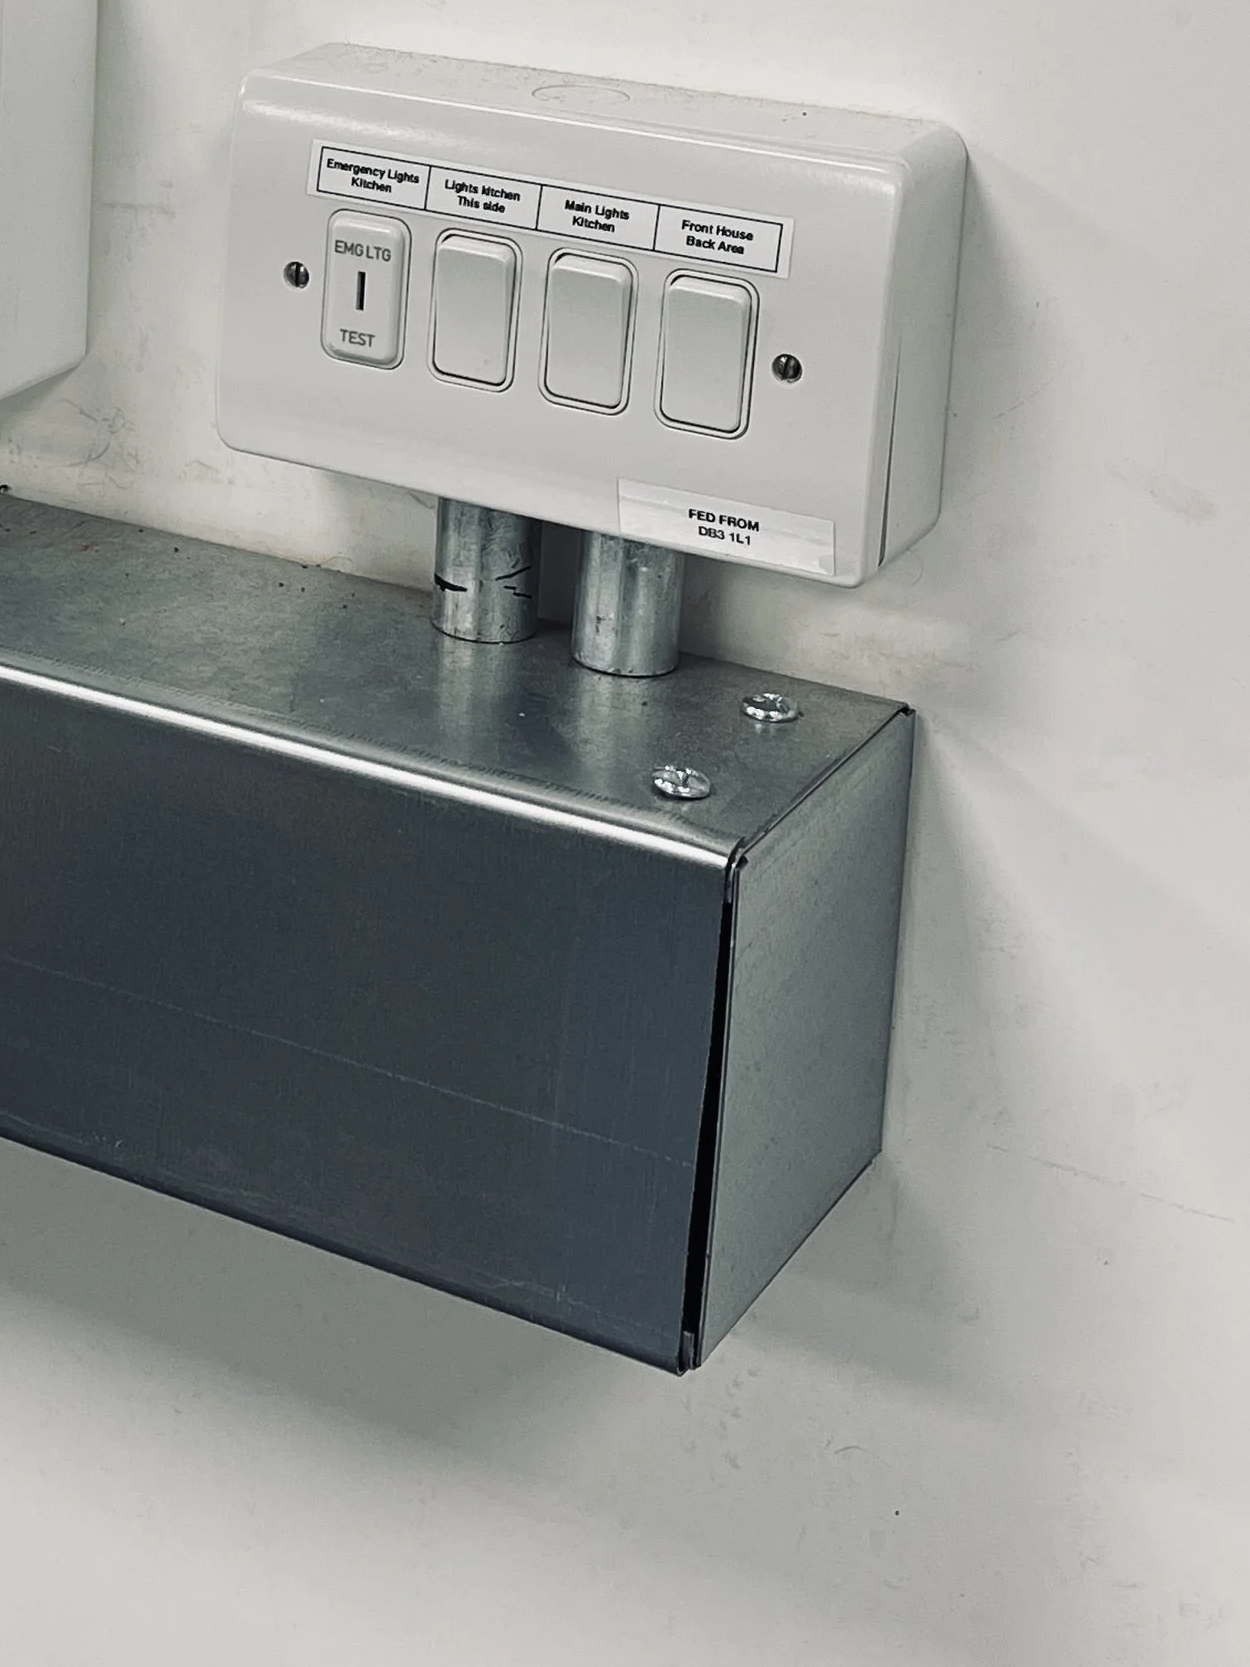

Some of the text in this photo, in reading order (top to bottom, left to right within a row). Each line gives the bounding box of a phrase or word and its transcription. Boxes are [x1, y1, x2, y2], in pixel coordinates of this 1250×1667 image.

[326, 158, 421, 185] Emergency Lights
[350, 176, 393, 194] Kitchen
[444, 178, 480, 196] Lights
[457, 195, 507, 214] This side
[564, 199, 630, 220] Main Lights
[572, 215, 616, 232] Kitchen
[681, 219, 755, 242] Front House
[334, 239, 392, 262] EMG LTG
[686, 234, 746, 256] Back Area
[340, 328, 375, 348] TEST
[688, 509, 759, 531] FED FROM
[698, 526, 725, 540] DB3
